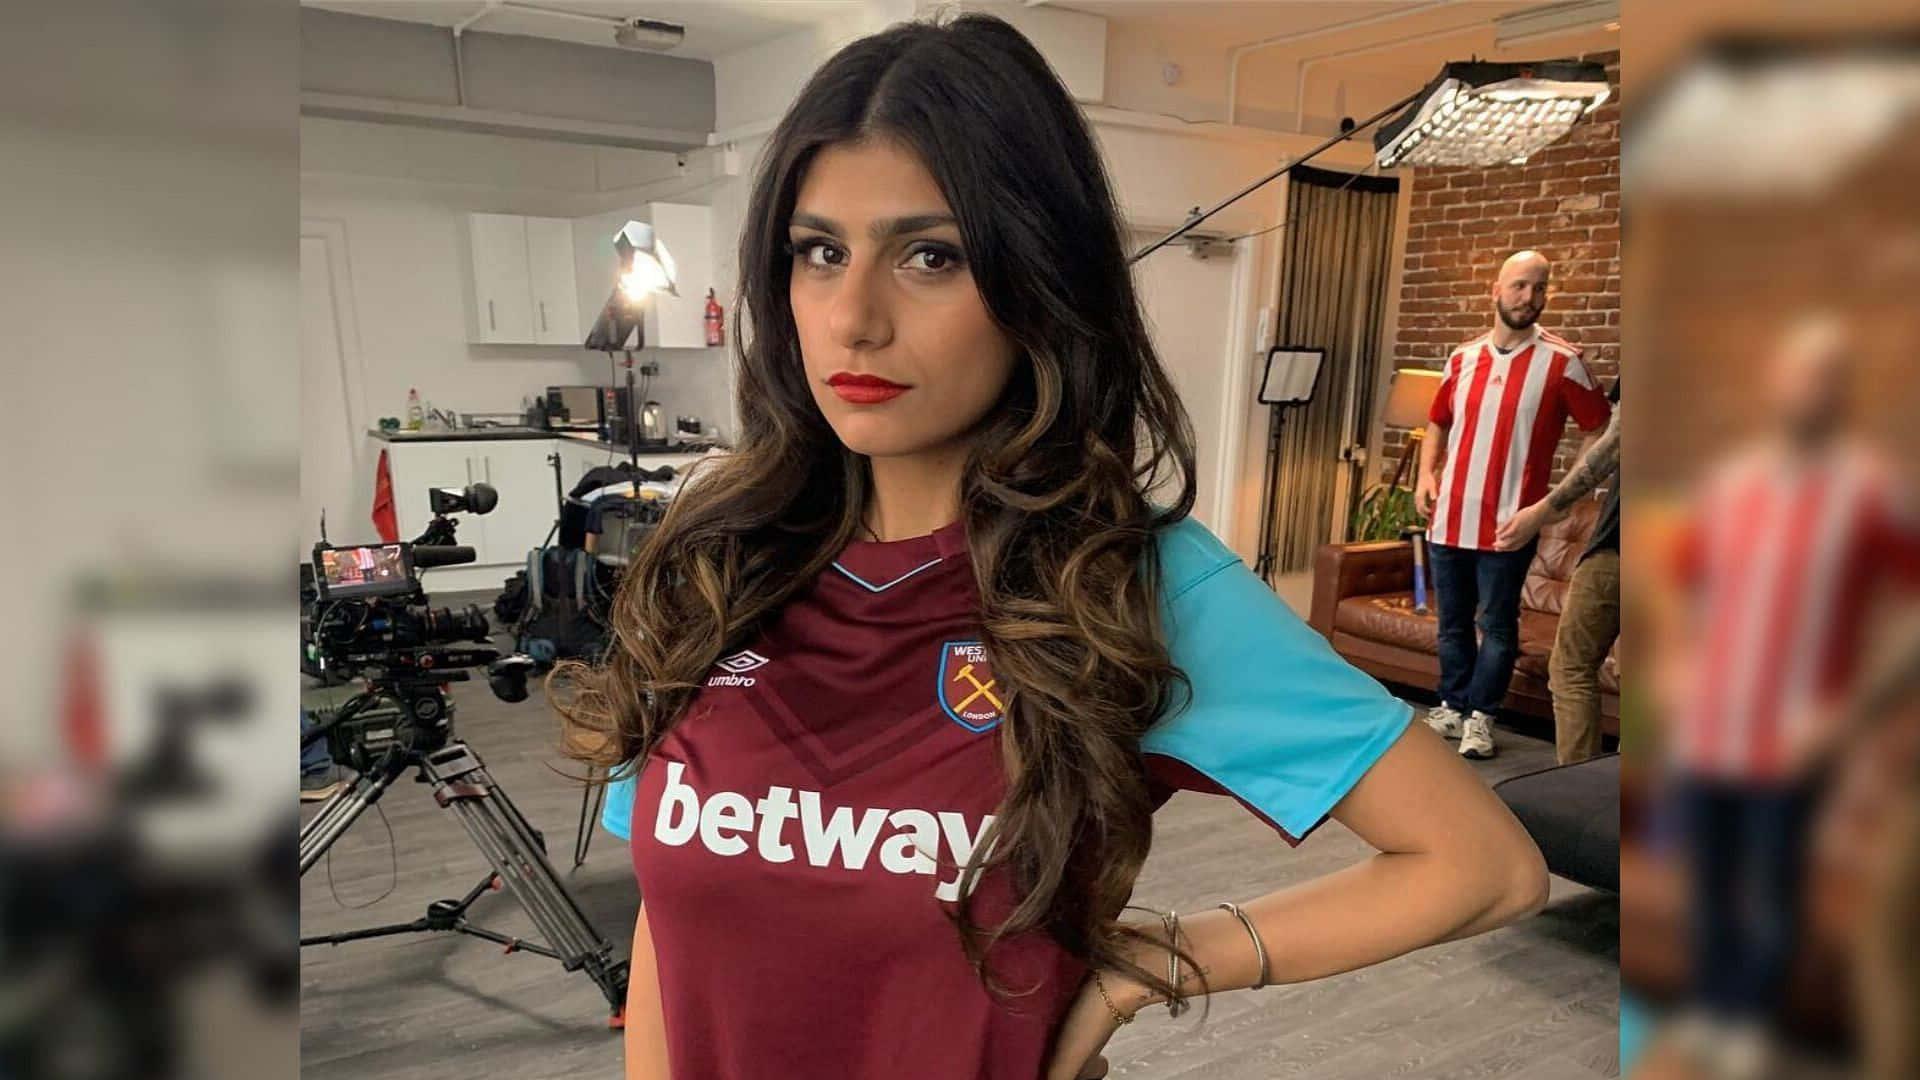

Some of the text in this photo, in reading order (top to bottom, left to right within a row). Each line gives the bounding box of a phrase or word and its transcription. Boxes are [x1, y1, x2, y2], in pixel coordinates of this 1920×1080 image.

[708, 674, 756, 687] umbro
[962, 711, 996, 720] LONDON
[654, 761, 1000, 902] betway
